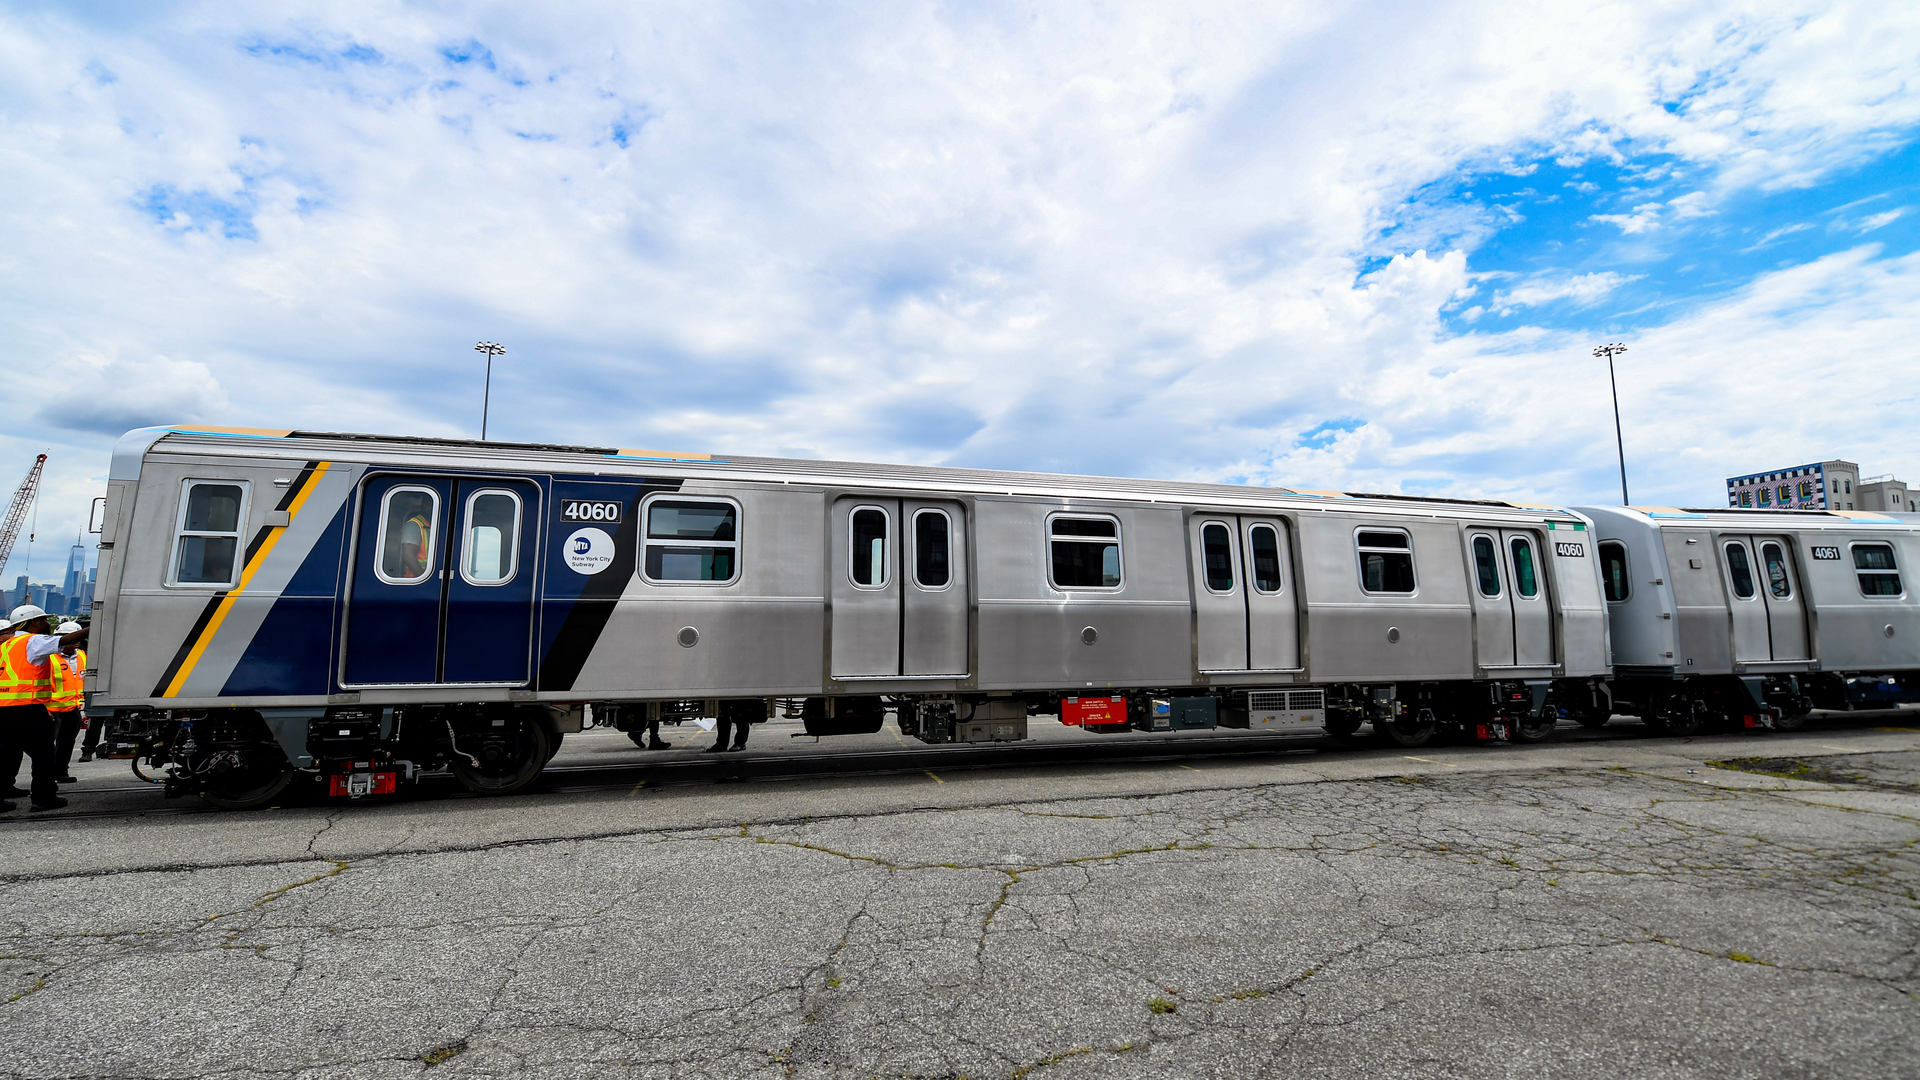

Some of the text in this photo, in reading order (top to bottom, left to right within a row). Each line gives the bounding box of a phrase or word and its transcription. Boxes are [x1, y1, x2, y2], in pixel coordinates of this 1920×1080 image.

[565, 502, 618, 520] 4060
[1558, 543, 1583, 556] 4060
[1815, 547, 1839, 559] 4061
